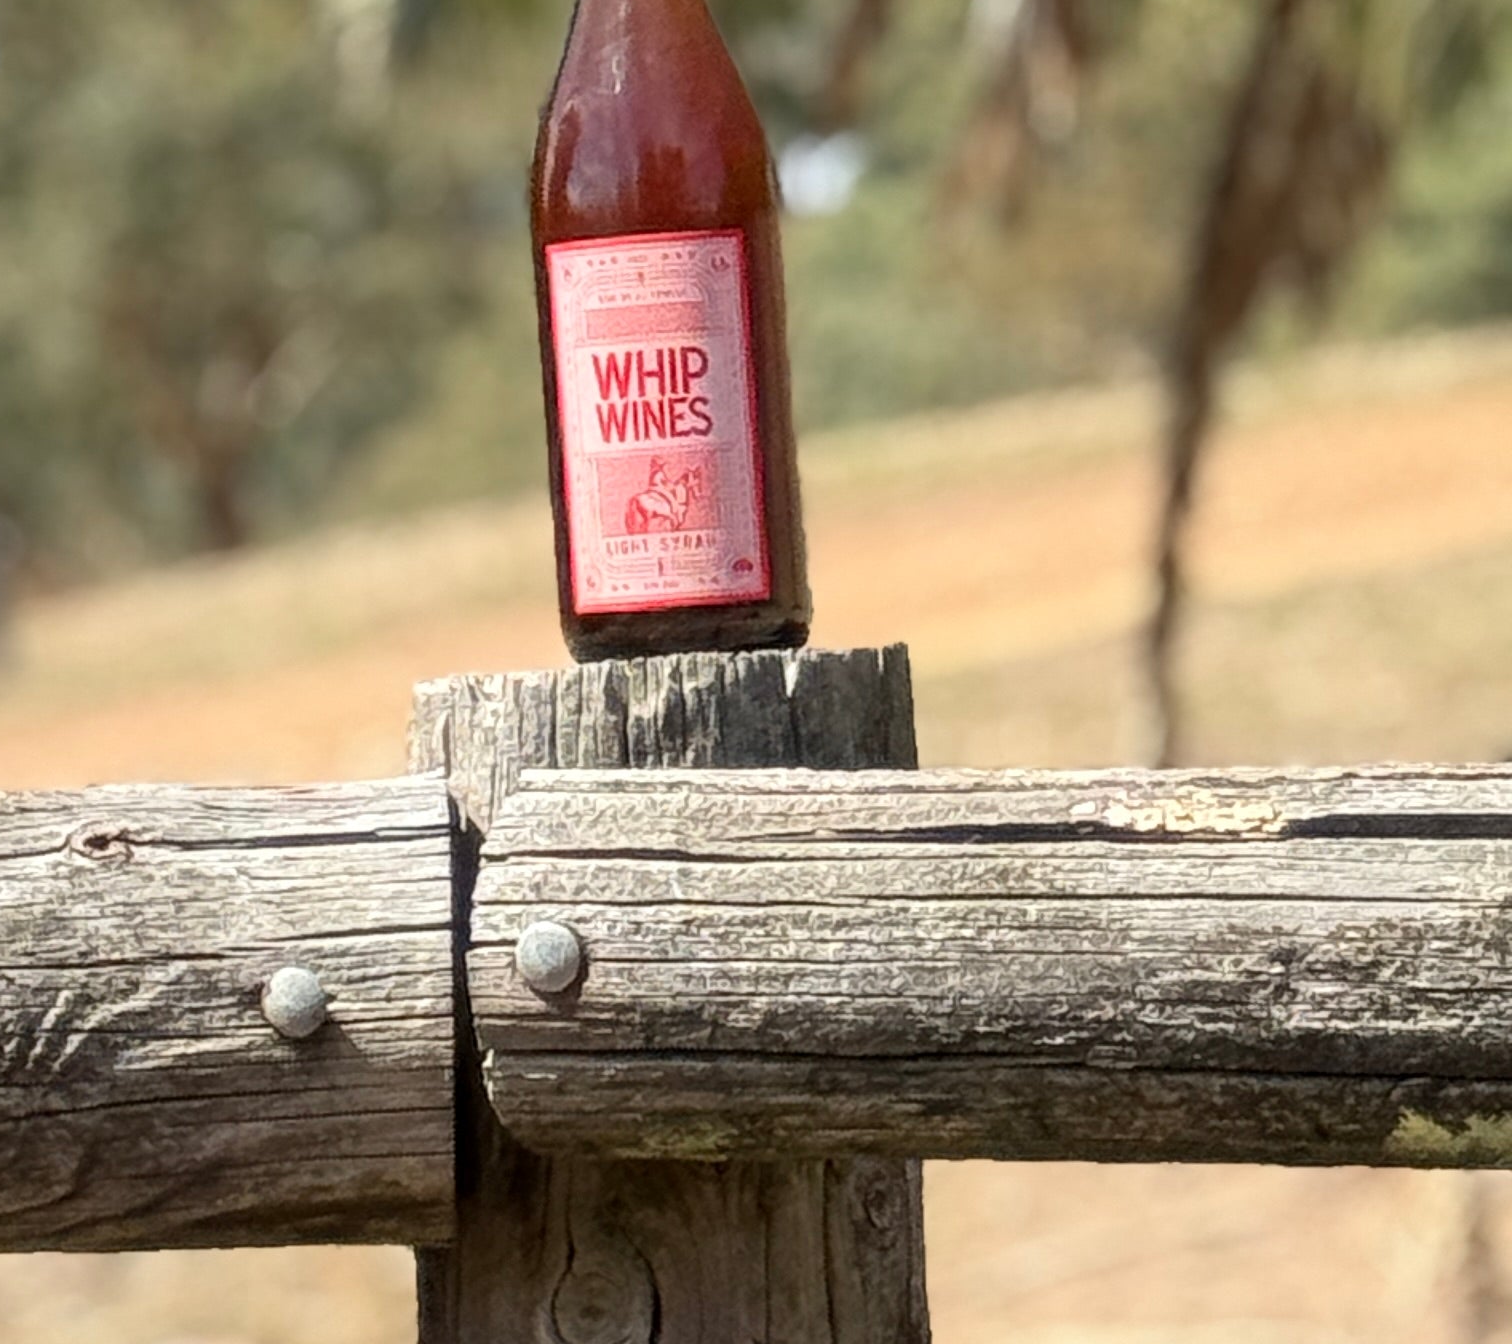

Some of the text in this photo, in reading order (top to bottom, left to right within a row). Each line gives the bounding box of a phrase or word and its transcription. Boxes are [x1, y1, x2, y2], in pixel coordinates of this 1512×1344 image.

[591, 345, 709, 401] WHIP
[595, 395, 714, 444] WINES
[605, 538, 650, 557] LIGHT
